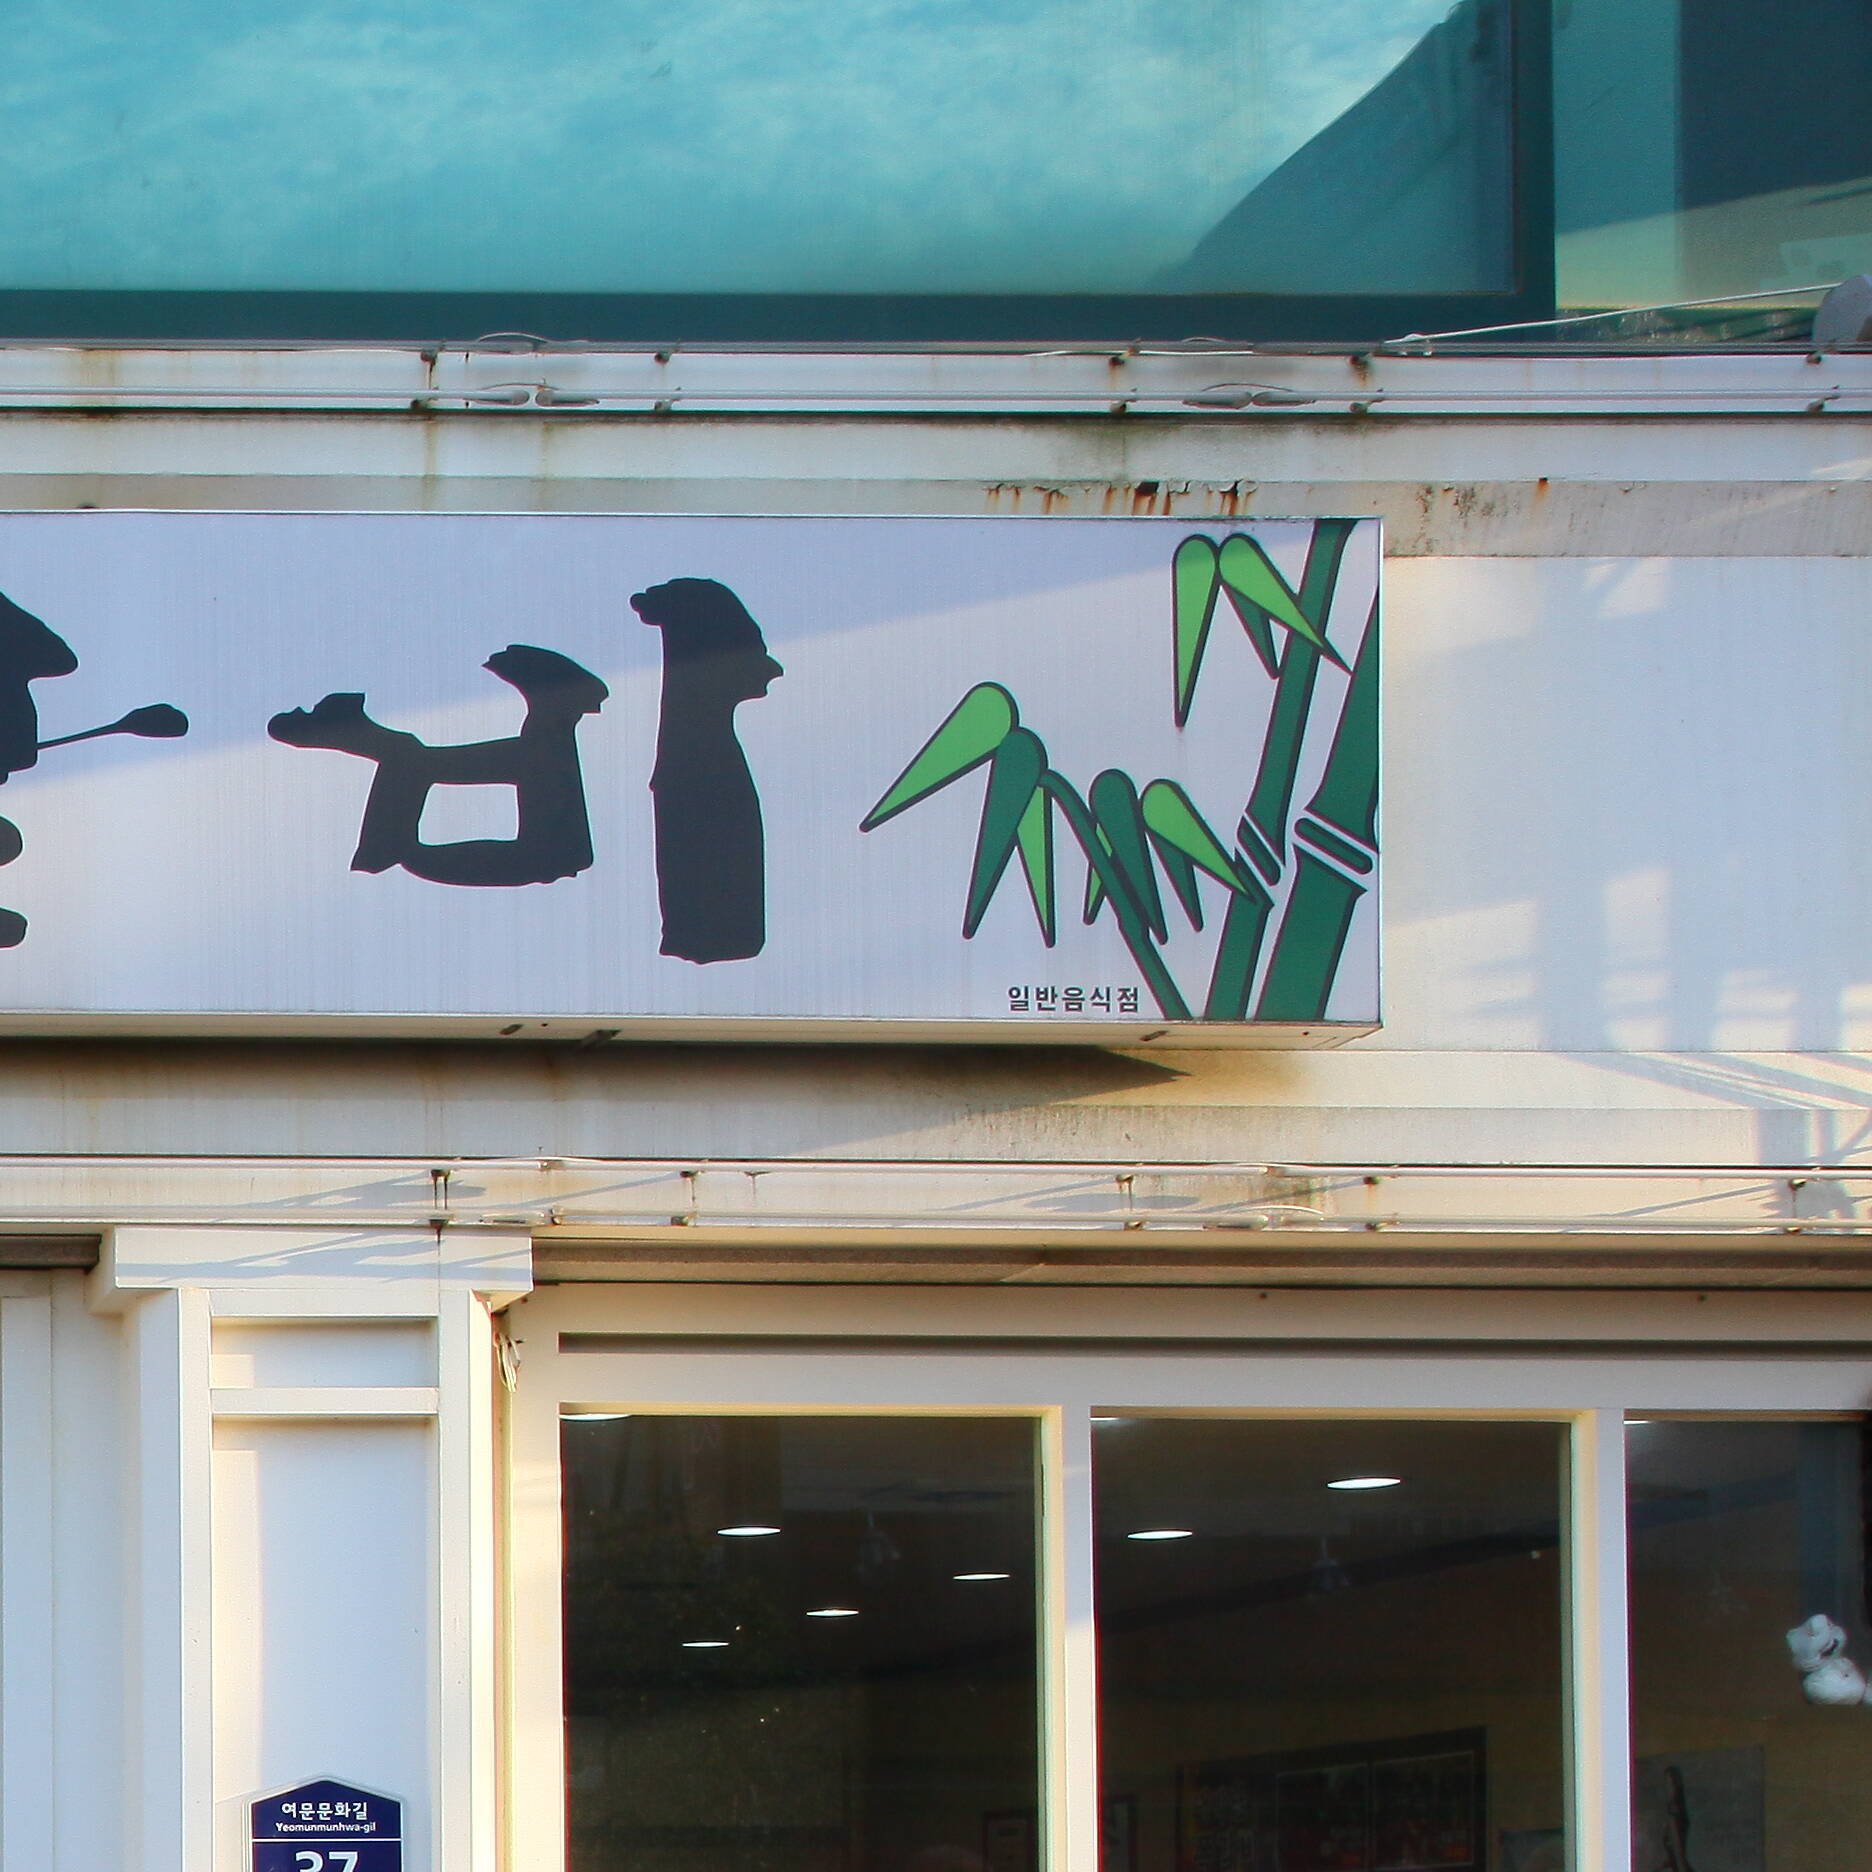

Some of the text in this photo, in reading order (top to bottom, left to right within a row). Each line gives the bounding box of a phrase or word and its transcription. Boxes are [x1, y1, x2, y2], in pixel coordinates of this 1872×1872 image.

[1008, 985, 1138, 1013] 일반음식점
[281, 1802, 369, 1820] 여문문화길
[275, 1822, 376, 1834] Yeomunmunhwa-gil
